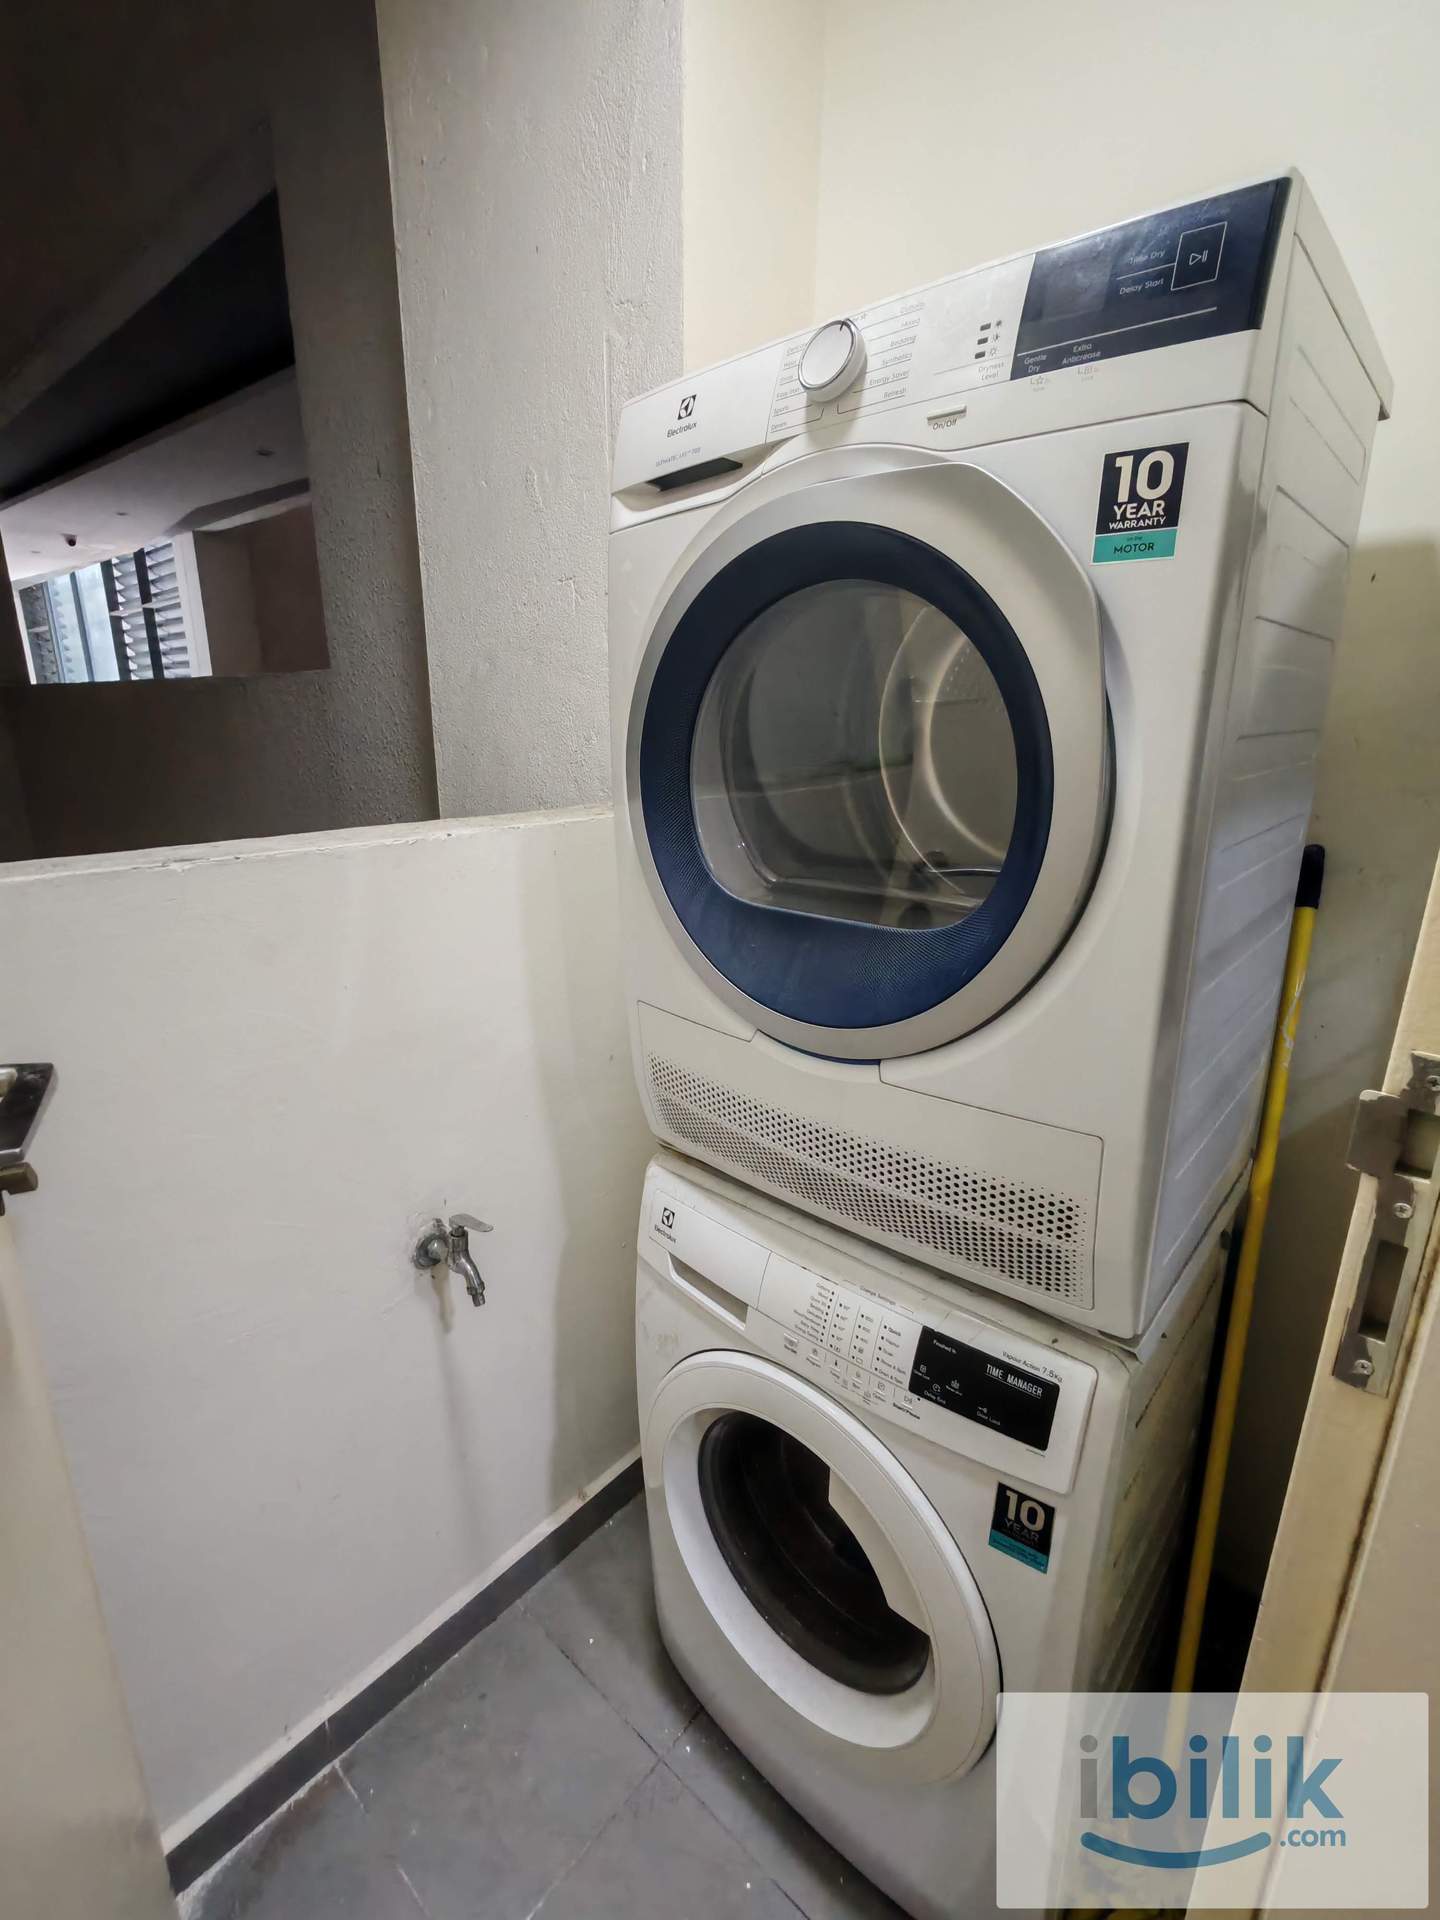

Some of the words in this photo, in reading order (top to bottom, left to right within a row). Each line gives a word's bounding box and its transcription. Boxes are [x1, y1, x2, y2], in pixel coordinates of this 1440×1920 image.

[1150, 250, 1166, 260] Dry
[1119, 282, 1142, 295] Delay
[1145, 277, 1164, 289] Start
[1073, 342, 1093, 353] Extra
[1024, 353, 1047, 365] Gentle
[1062, 351, 1101, 365] Anticrease
[981, 371, 999, 380] Level
[1028, 363, 1041, 374] Dry
[666, 422, 698, 438] Electrolux
[932, 418, 958, 430] On/Off
[1115, 450, 1175, 503] 10
[1113, 500, 1166, 520] YEAR
[1109, 516, 1166, 530] WARRANTY
[1113, 542, 1155, 554] MOTOR
[1022, 1359, 1041, 1372] Action
[986, 1363, 1003, 1380] TIME
[1006, 1373, 1044, 1397] MANAGER
[1006, 1490, 1045, 1531] 10
[1004, 1518, 1040, 1541] YEAR
